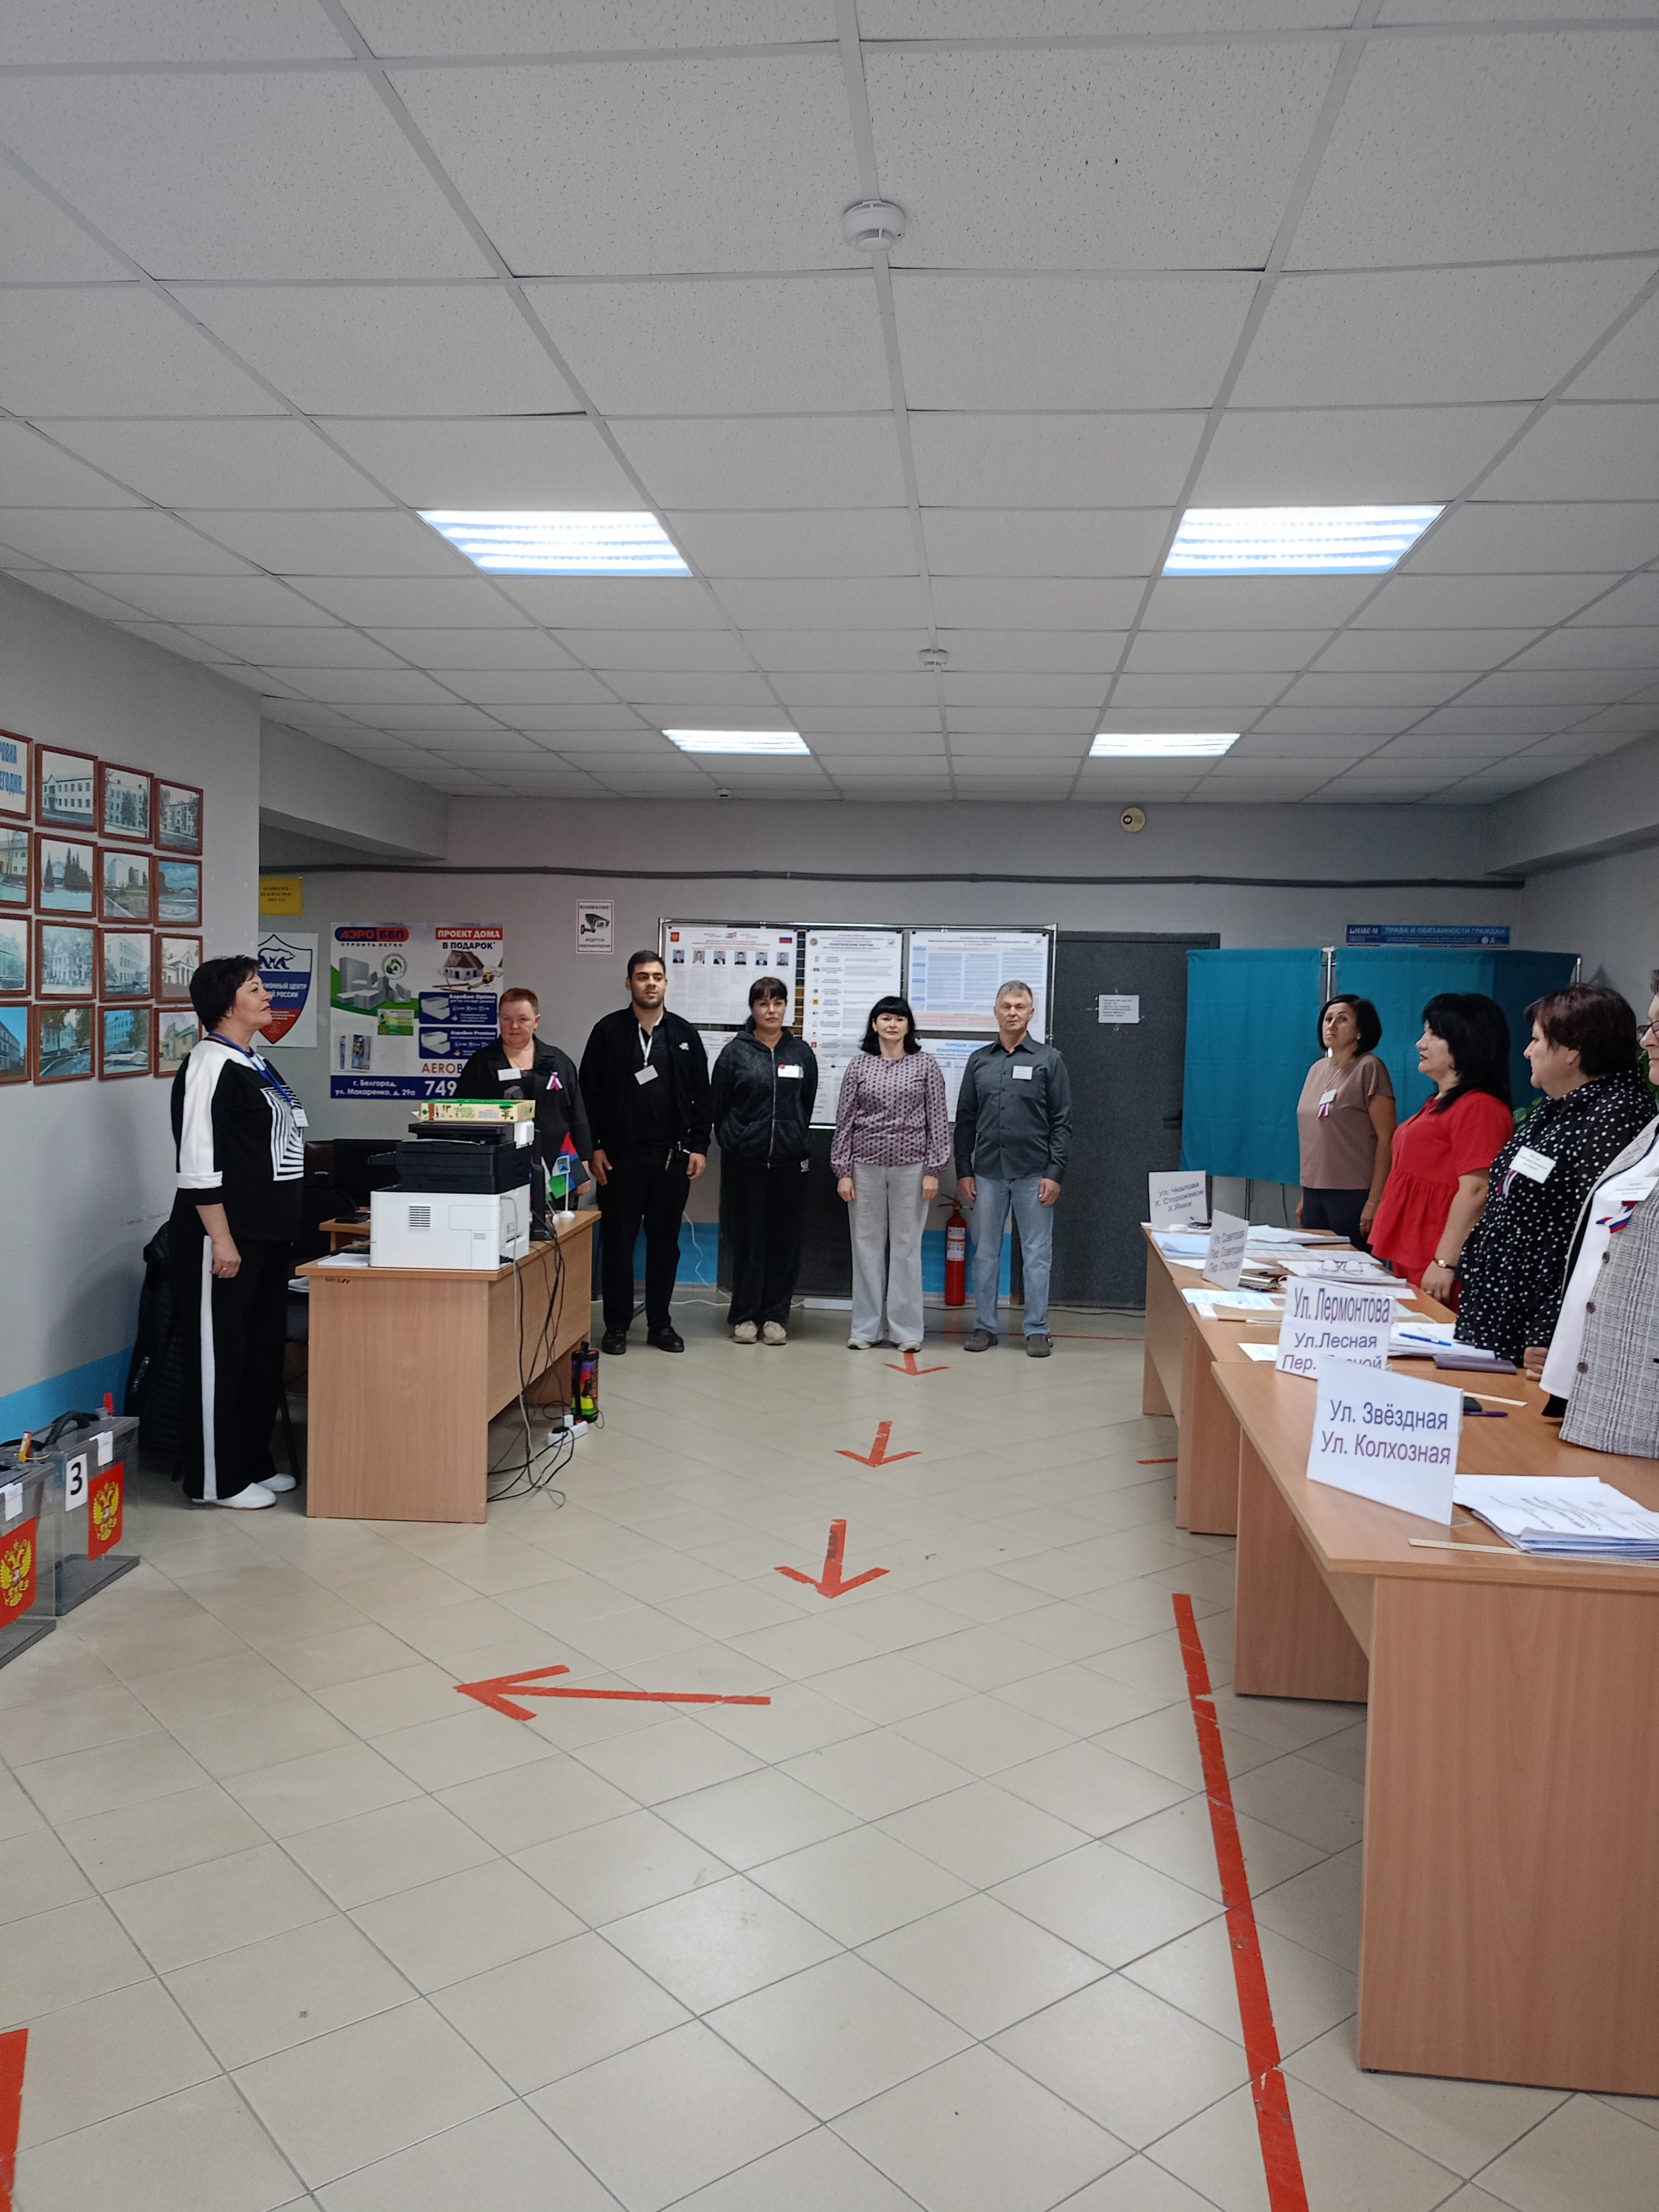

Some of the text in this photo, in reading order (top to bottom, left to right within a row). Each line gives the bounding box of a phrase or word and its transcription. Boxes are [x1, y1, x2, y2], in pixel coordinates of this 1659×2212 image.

[473, 930, 500, 939] ДОМА
[347, 1088, 391, 1096] Макаренко,
[424, 1080, 457, 1096] 749
[1171, 1182, 1199, 1193] Чкалова
[1163, 1190, 1204, 1205] Сторожевое
[1294, 1287, 1390, 1324] Ул. Лермонтова
[1282, 1354, 1316, 1373] Пер.
[1330, 1399, 1448, 1432] Ул. Звёздная
[1321, 1430, 1450, 1464] Ул. Колхозная
[70, 1462, 83, 1495] 3
